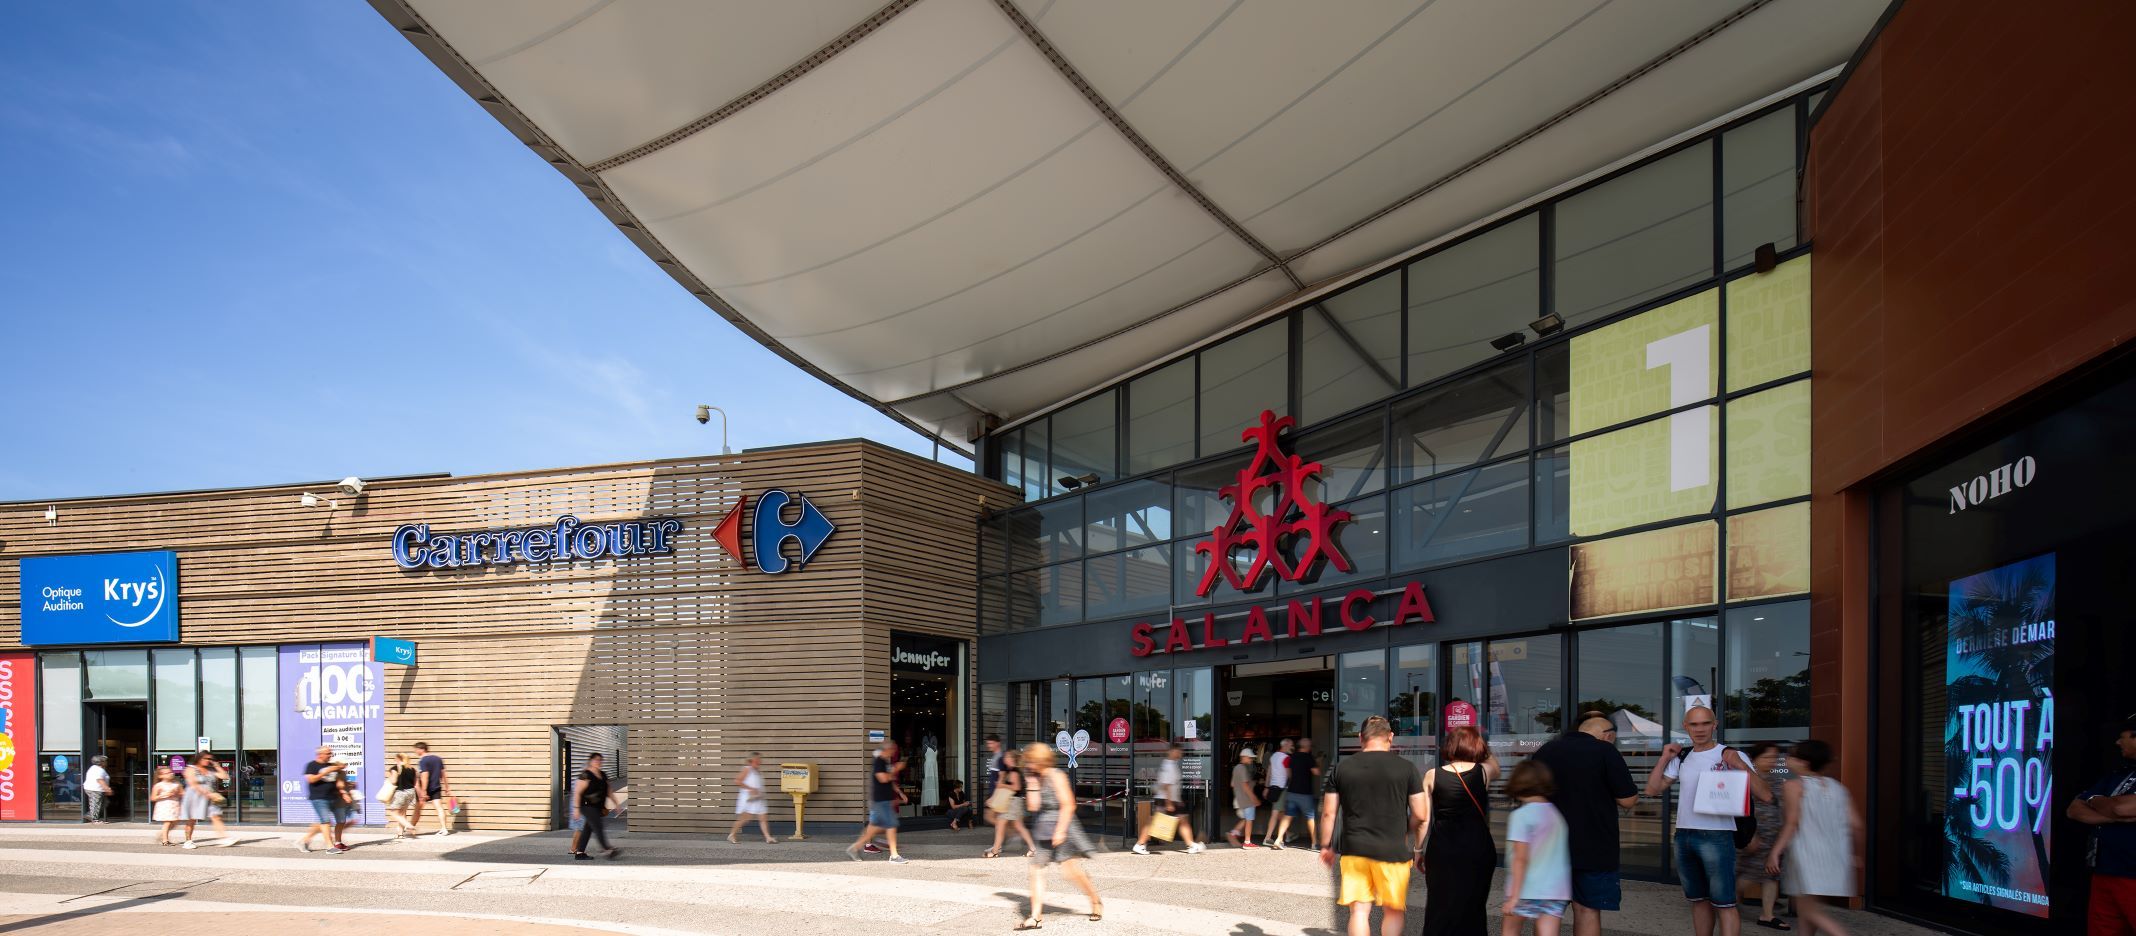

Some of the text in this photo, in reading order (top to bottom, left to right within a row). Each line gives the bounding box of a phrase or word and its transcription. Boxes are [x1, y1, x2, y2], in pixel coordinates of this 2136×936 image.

[1646, 323, 1710, 493] 1
[1949, 455, 2036, 515] NOHO
[392, 515, 683, 569] Carrefour
[42, 586, 82, 600] Optique
[104, 578, 158, 607] Krys
[42, 599, 84, 611] Audition
[1131, 581, 1435, 657] SALANCA
[301, 651, 319, 659] Pack
[321, 650, 358, 659] Signature
[395, 646, 411, 656] Krys
[891, 646, 951, 671] Jennyfer
[1312, 688, 1349, 702] celo
[302, 705, 380, 719] GAGNANT
[1959, 687, 2054, 752] TOUT À
[1972, 883, 1996, 896] ARTICLES
[1996, 887, 2022, 901] SIGNALÉS
[2023, 892, 2031, 903] EN
[2031, 894, 2050, 907] MAGA
